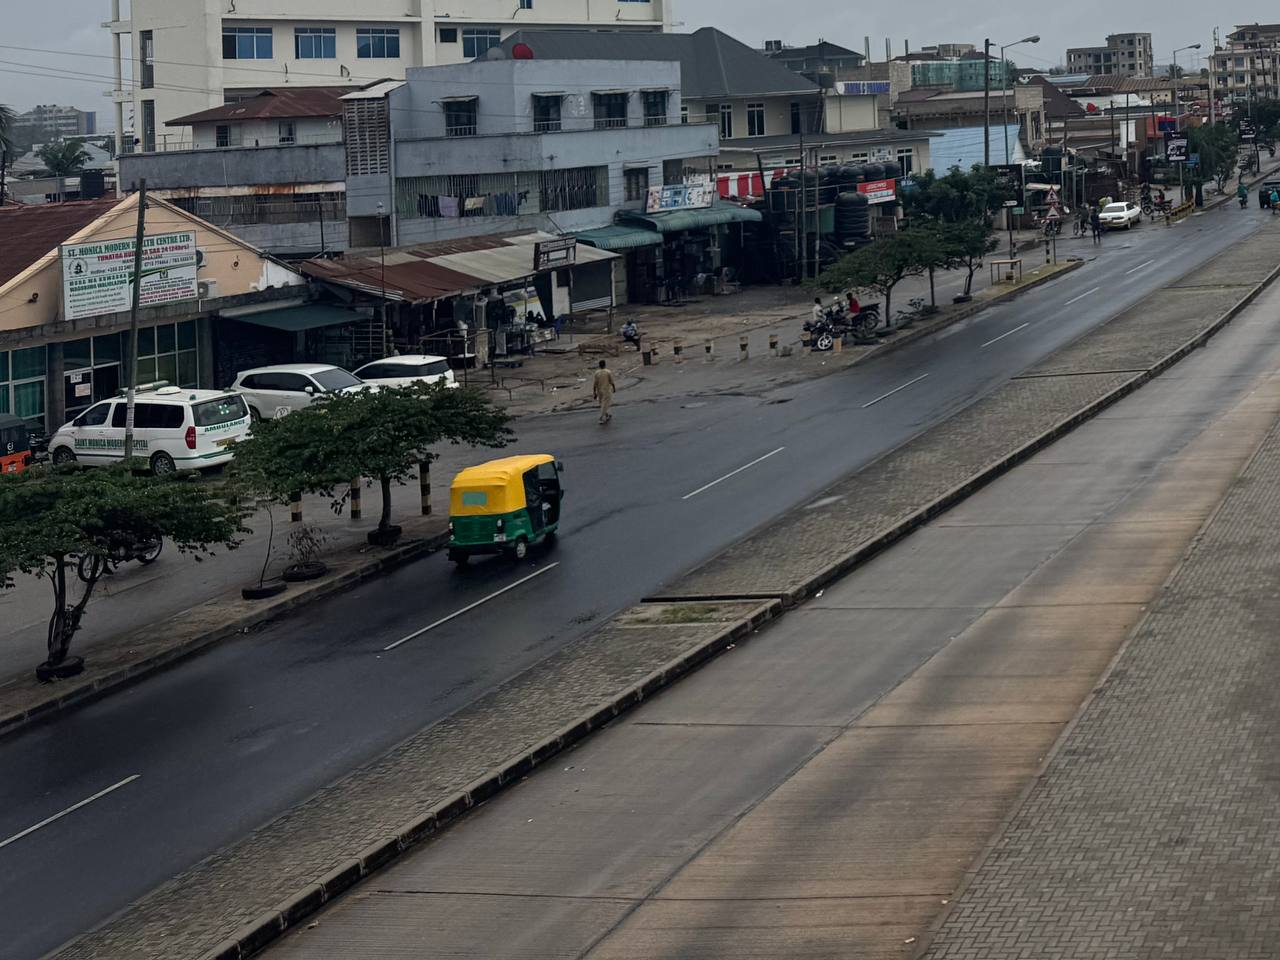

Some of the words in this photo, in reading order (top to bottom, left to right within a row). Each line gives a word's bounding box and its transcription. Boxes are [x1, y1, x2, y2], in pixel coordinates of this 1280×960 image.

[79, 245, 103, 256] MONICA
[104, 241, 130, 253] MODERN
[131, 239, 154, 250] HLTH
[156, 236, 178, 246] CENTRE
[204, 419, 245, 433] AMBULANCE
